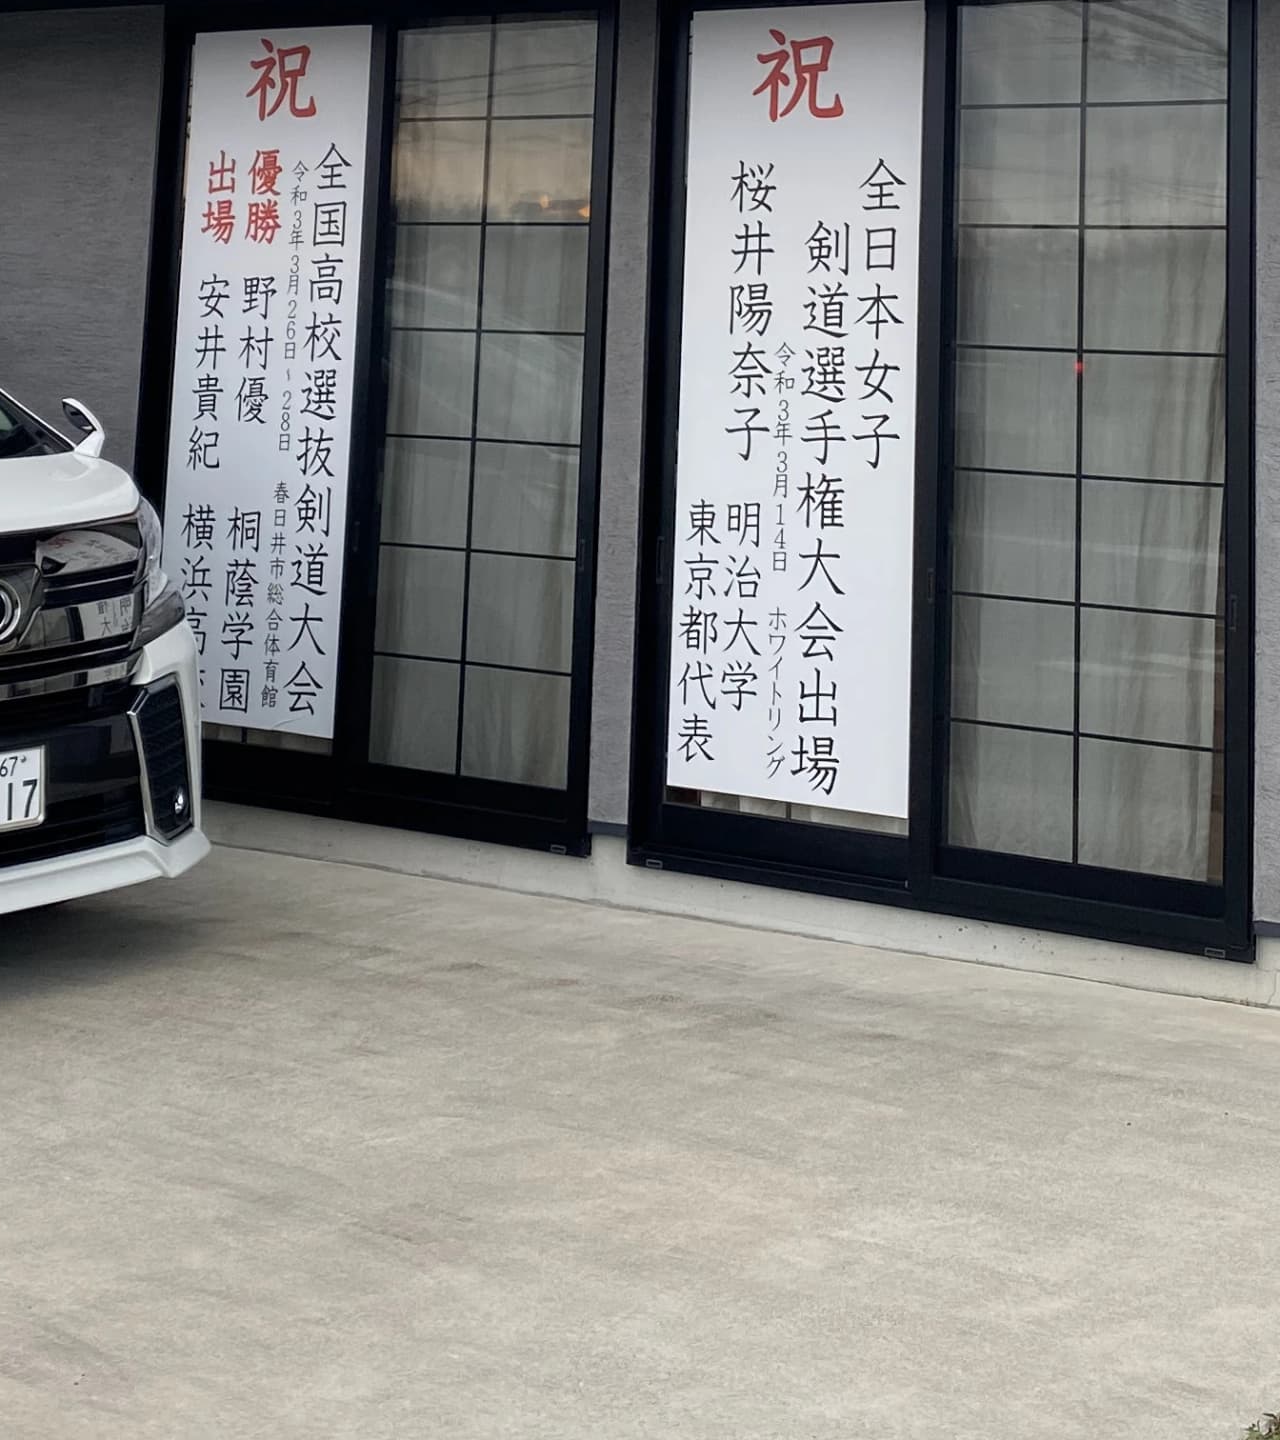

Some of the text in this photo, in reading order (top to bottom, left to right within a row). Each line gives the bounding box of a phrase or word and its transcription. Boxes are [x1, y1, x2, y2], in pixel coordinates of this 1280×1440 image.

[200, 150, 236, 246] 出場
[246, 38, 317, 122] 祝
[753, 28, 844, 122] 祝
[186, 273, 231, 472] 安井貴紀
[219, 149, 282, 714] 優勝 野村優 桐蔭学園
[283, 142, 353, 716] 全国高校選抜剣道大会
[720, 159, 778, 712] 桜井陽奈子 明治大学
[851, 158, 907, 469] 全日本女子
[261, 480, 290, 709] 春日井市総合体育館
[677, 498, 721, 762] 東京都代表
[765, 341, 797, 780] 令和3年3月14日 ホワイトリング
[790, 220, 850, 796] 剣道選手権大会出場
